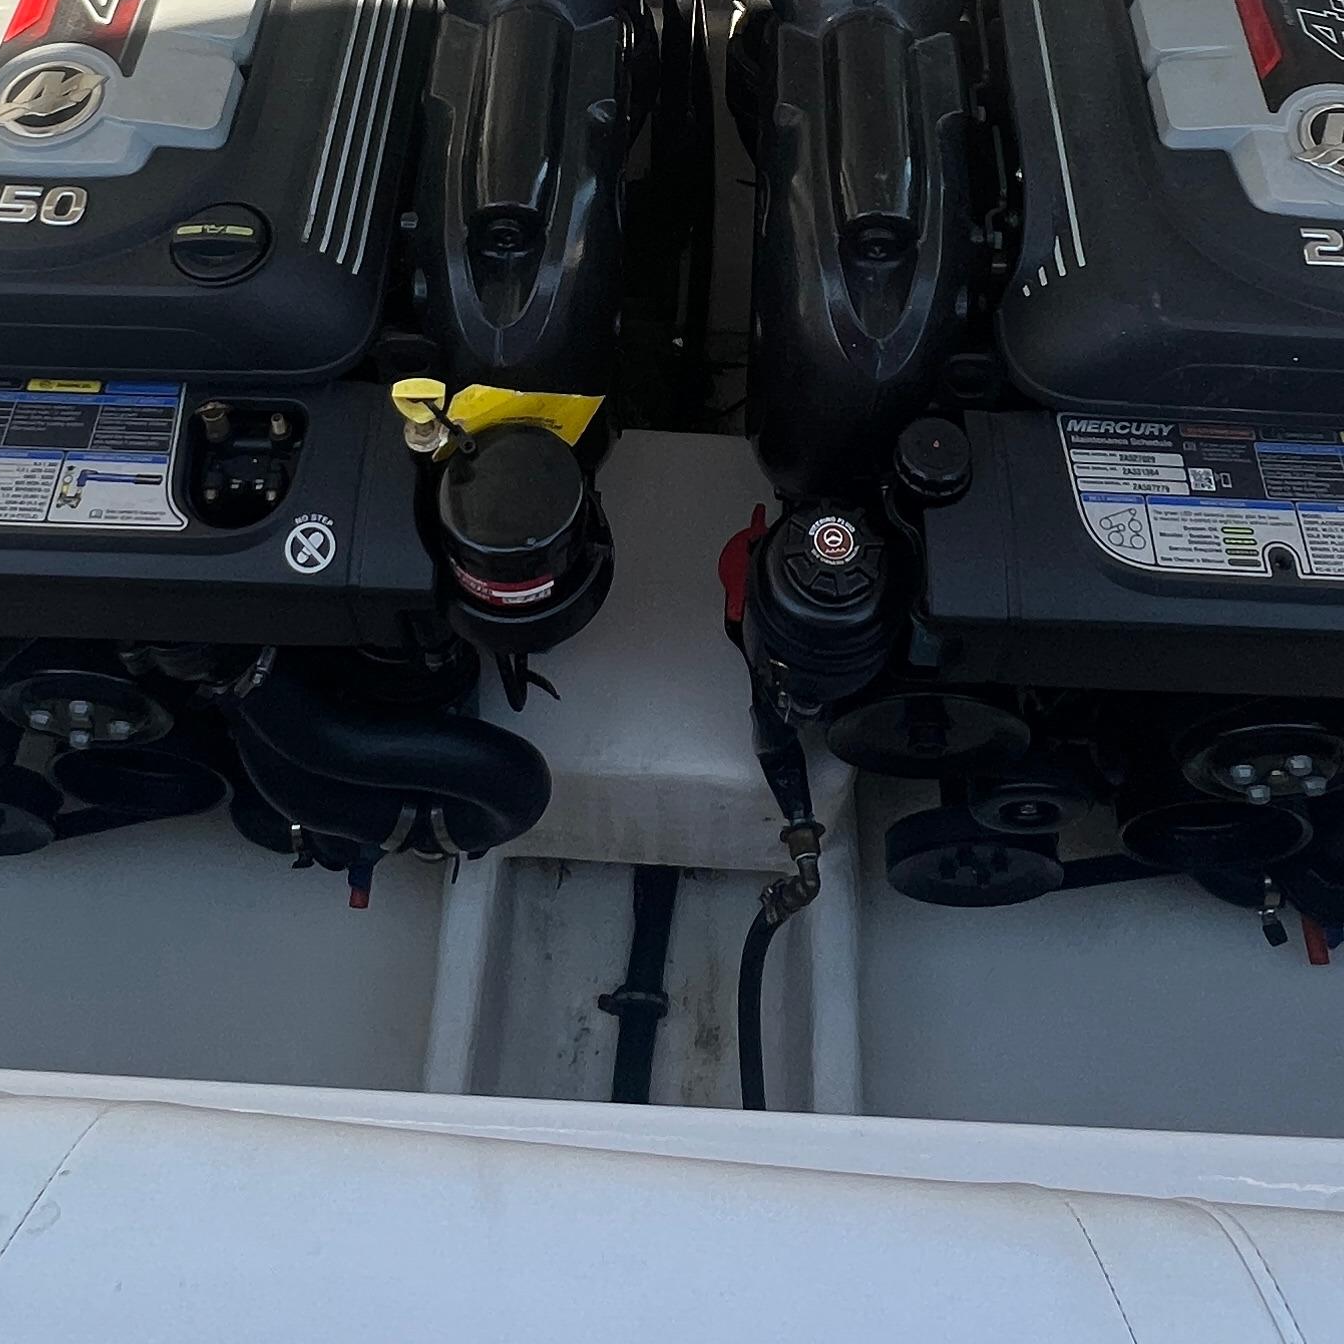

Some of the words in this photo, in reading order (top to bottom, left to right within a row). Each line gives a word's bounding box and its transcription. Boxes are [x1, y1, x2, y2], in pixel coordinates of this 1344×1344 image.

[1066, 419, 1175, 436] MERCURY
[295, 514, 309, 524] NO
[310, 513, 334, 526] STEP
